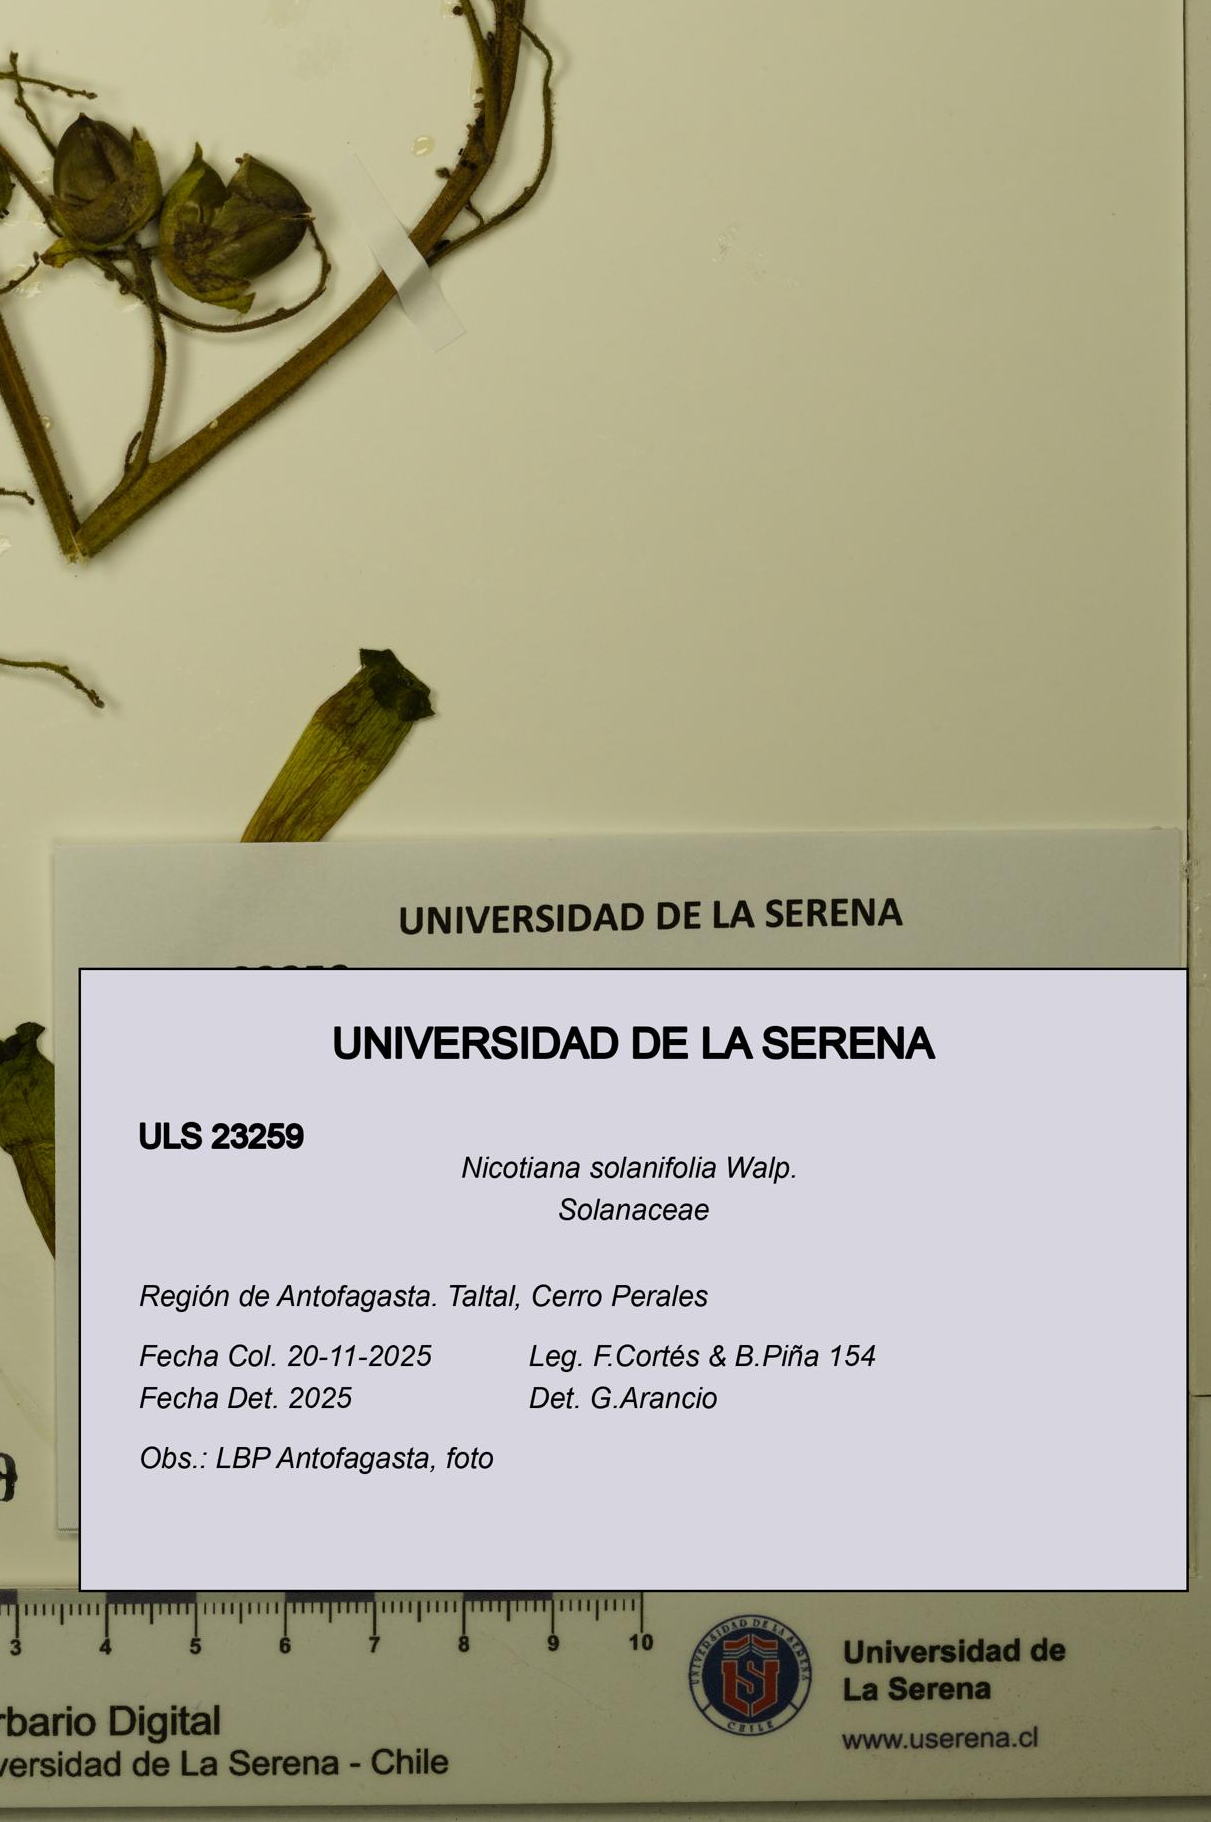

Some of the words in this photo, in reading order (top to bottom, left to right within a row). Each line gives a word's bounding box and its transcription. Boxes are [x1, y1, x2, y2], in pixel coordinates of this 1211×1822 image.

[399, 902, 645, 936] UNIVERSIDAD
[657, 900, 703, 931] DE
[713, 899, 756, 929] LA
[765, 897, 904, 929] SERENA
[9, 1639, 22, 1656] 3
[98, 1639, 113, 1656] 4
[189, 1638, 202, 1655] 5
[279, 1637, 292, 1655] 6
[368, 1637, 381, 1654] 7
[457, 1636, 471, 1653] 8
[546, 1635, 560, 1653] 9
[628, 1634, 655, 1652] 10
[691, 1618, 748, 1685] UNIVERSIDAD
[844, 1637, 1021, 1665] Universidad
[1029, 1636, 1067, 1663] de
[843, 1677, 879, 1703] La
[887, 1675, 992, 1702] Serena
[109, 1704, 222, 1746] Digital
[726, 1719, 774, 1733] CHILE
[841, 1725, 1039, 1751] www.userena.cl
[132, 1750, 171, 1778] de
[181, 1749, 218, 1777] La
[228, 1748, 339, 1777] Serena
[371, 1747, 449, 1776] Chile
